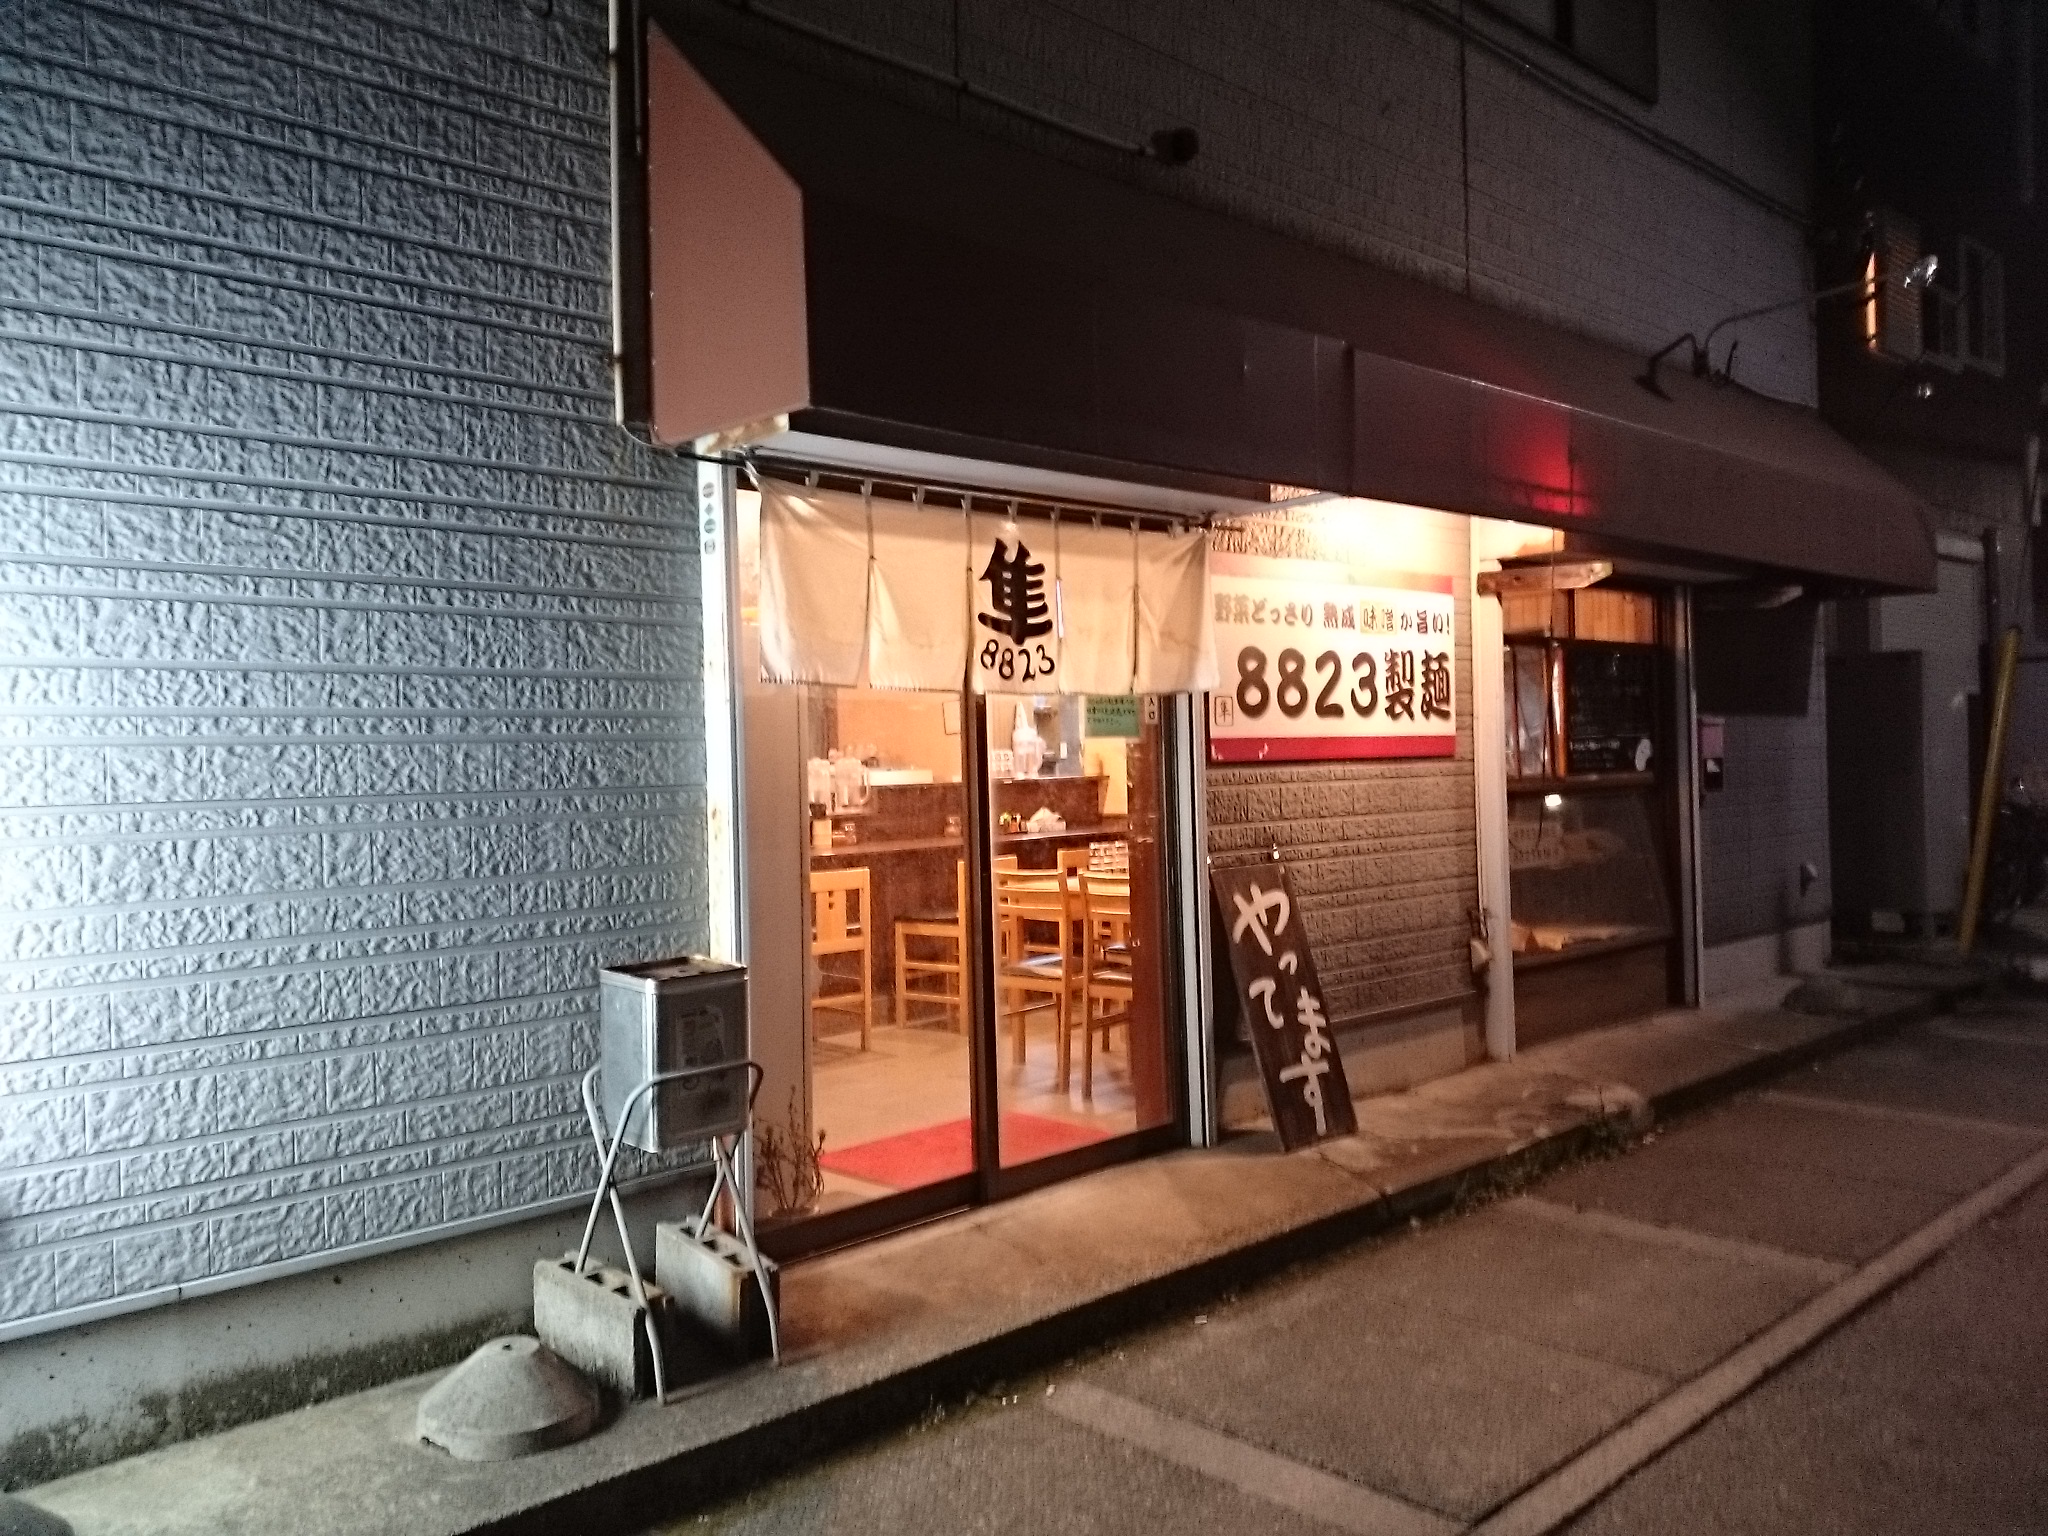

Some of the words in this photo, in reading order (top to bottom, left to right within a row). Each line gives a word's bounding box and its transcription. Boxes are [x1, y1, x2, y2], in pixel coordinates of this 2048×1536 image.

[977, 537, 1053, 644] 隼
[980, 639, 1055, 682] 8823
[1236, 645, 1452, 722] 8823製麺
